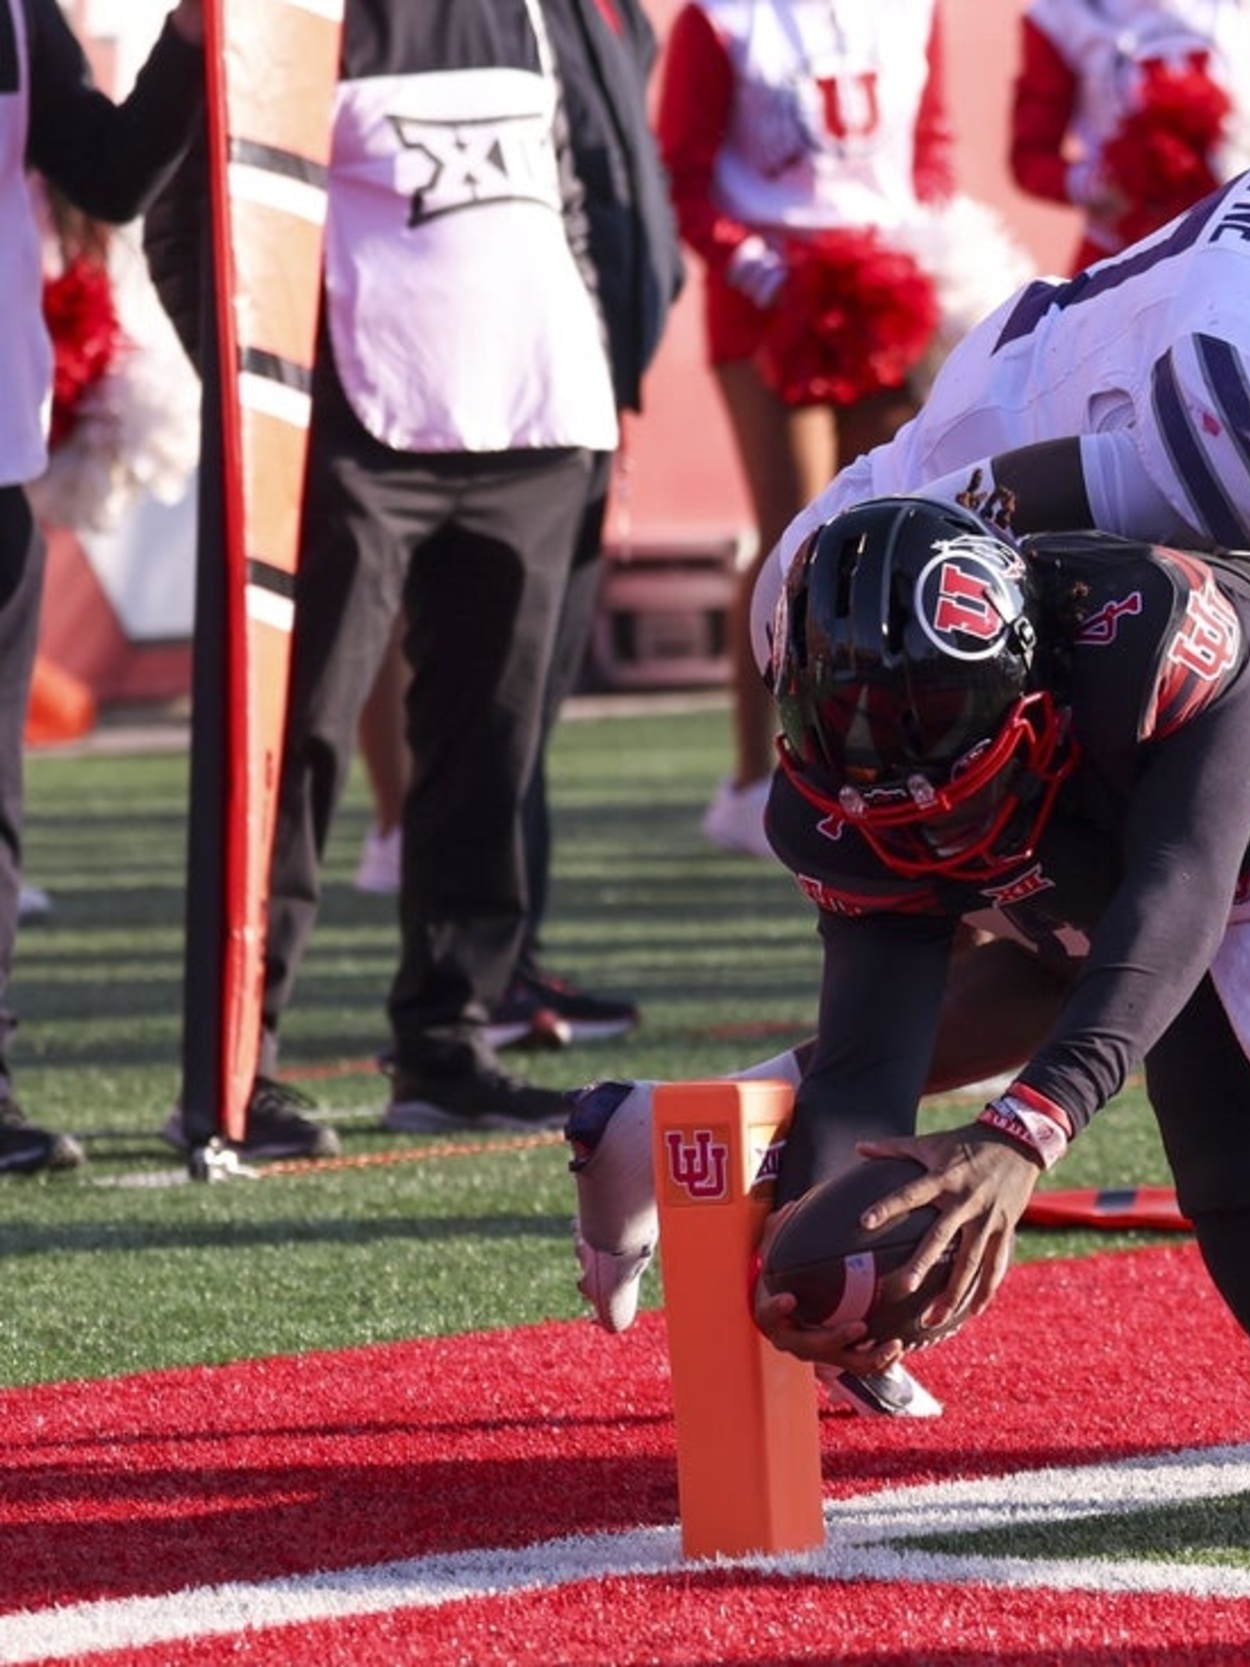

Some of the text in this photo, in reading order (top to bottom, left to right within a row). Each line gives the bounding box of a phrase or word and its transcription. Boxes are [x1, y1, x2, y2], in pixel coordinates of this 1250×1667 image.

[816, 72, 879, 139] U
[933, 562, 1004, 640] U
[1074, 590, 1142, 645] 4
